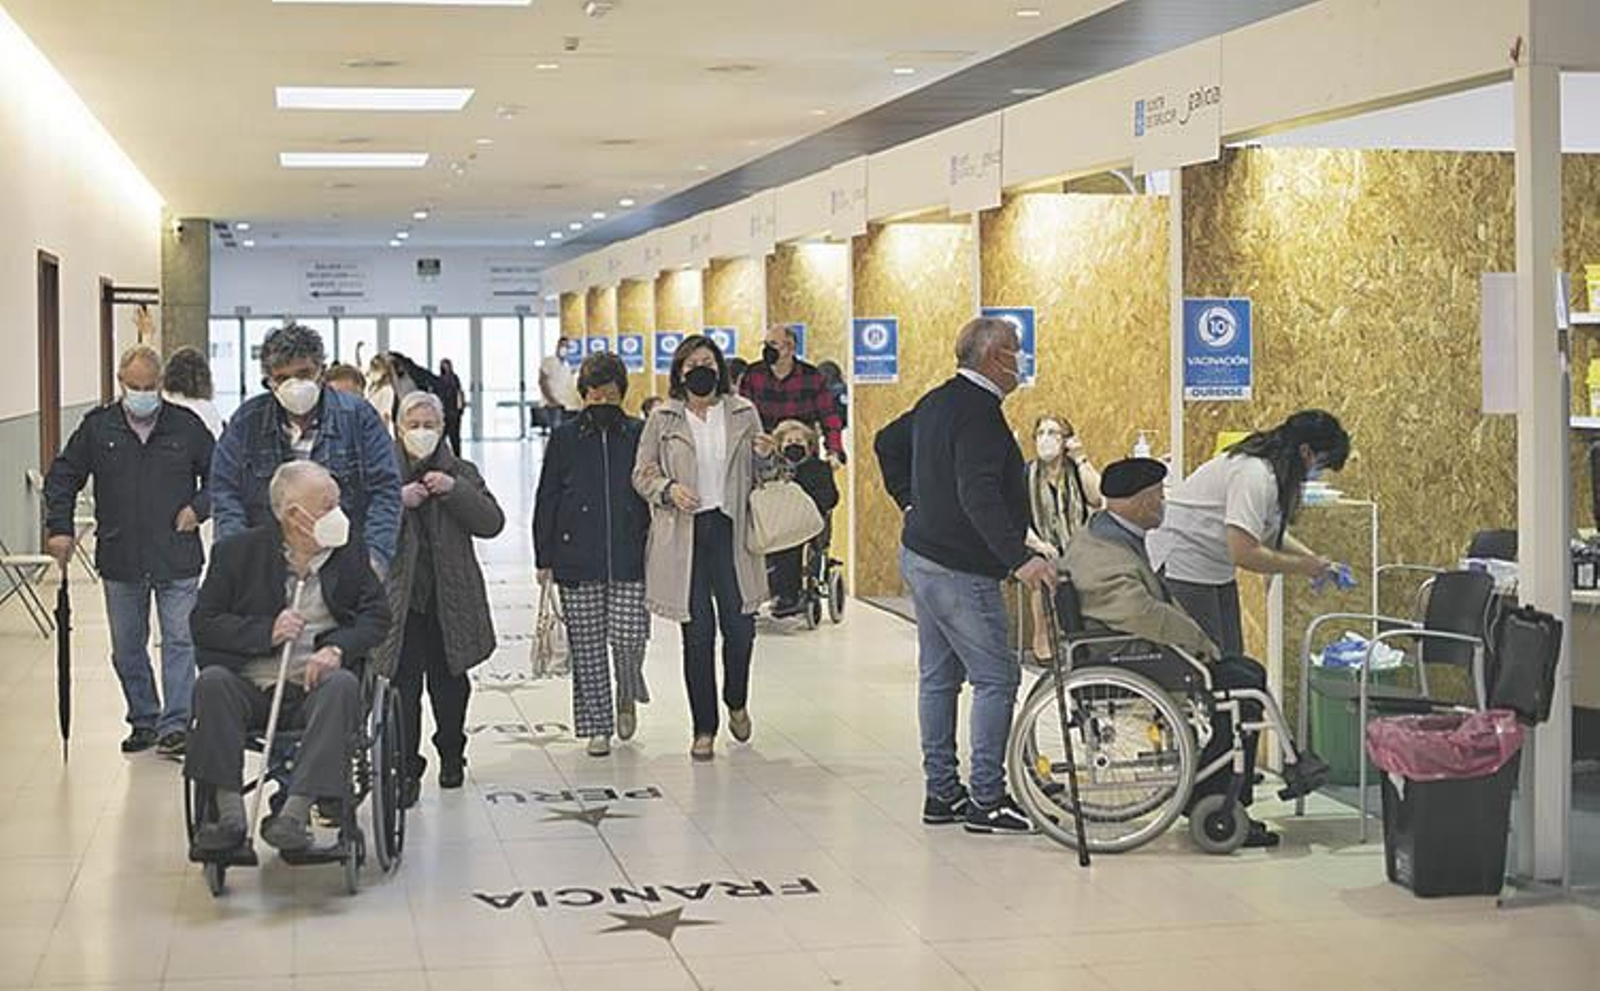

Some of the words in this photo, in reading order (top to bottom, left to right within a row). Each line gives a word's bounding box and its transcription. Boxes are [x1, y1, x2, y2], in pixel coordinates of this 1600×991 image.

[1209, 320, 1226, 335] 10
[1192, 388, 1244, 397] OURENSE
[473, 877, 821, 909] FRANCIA
